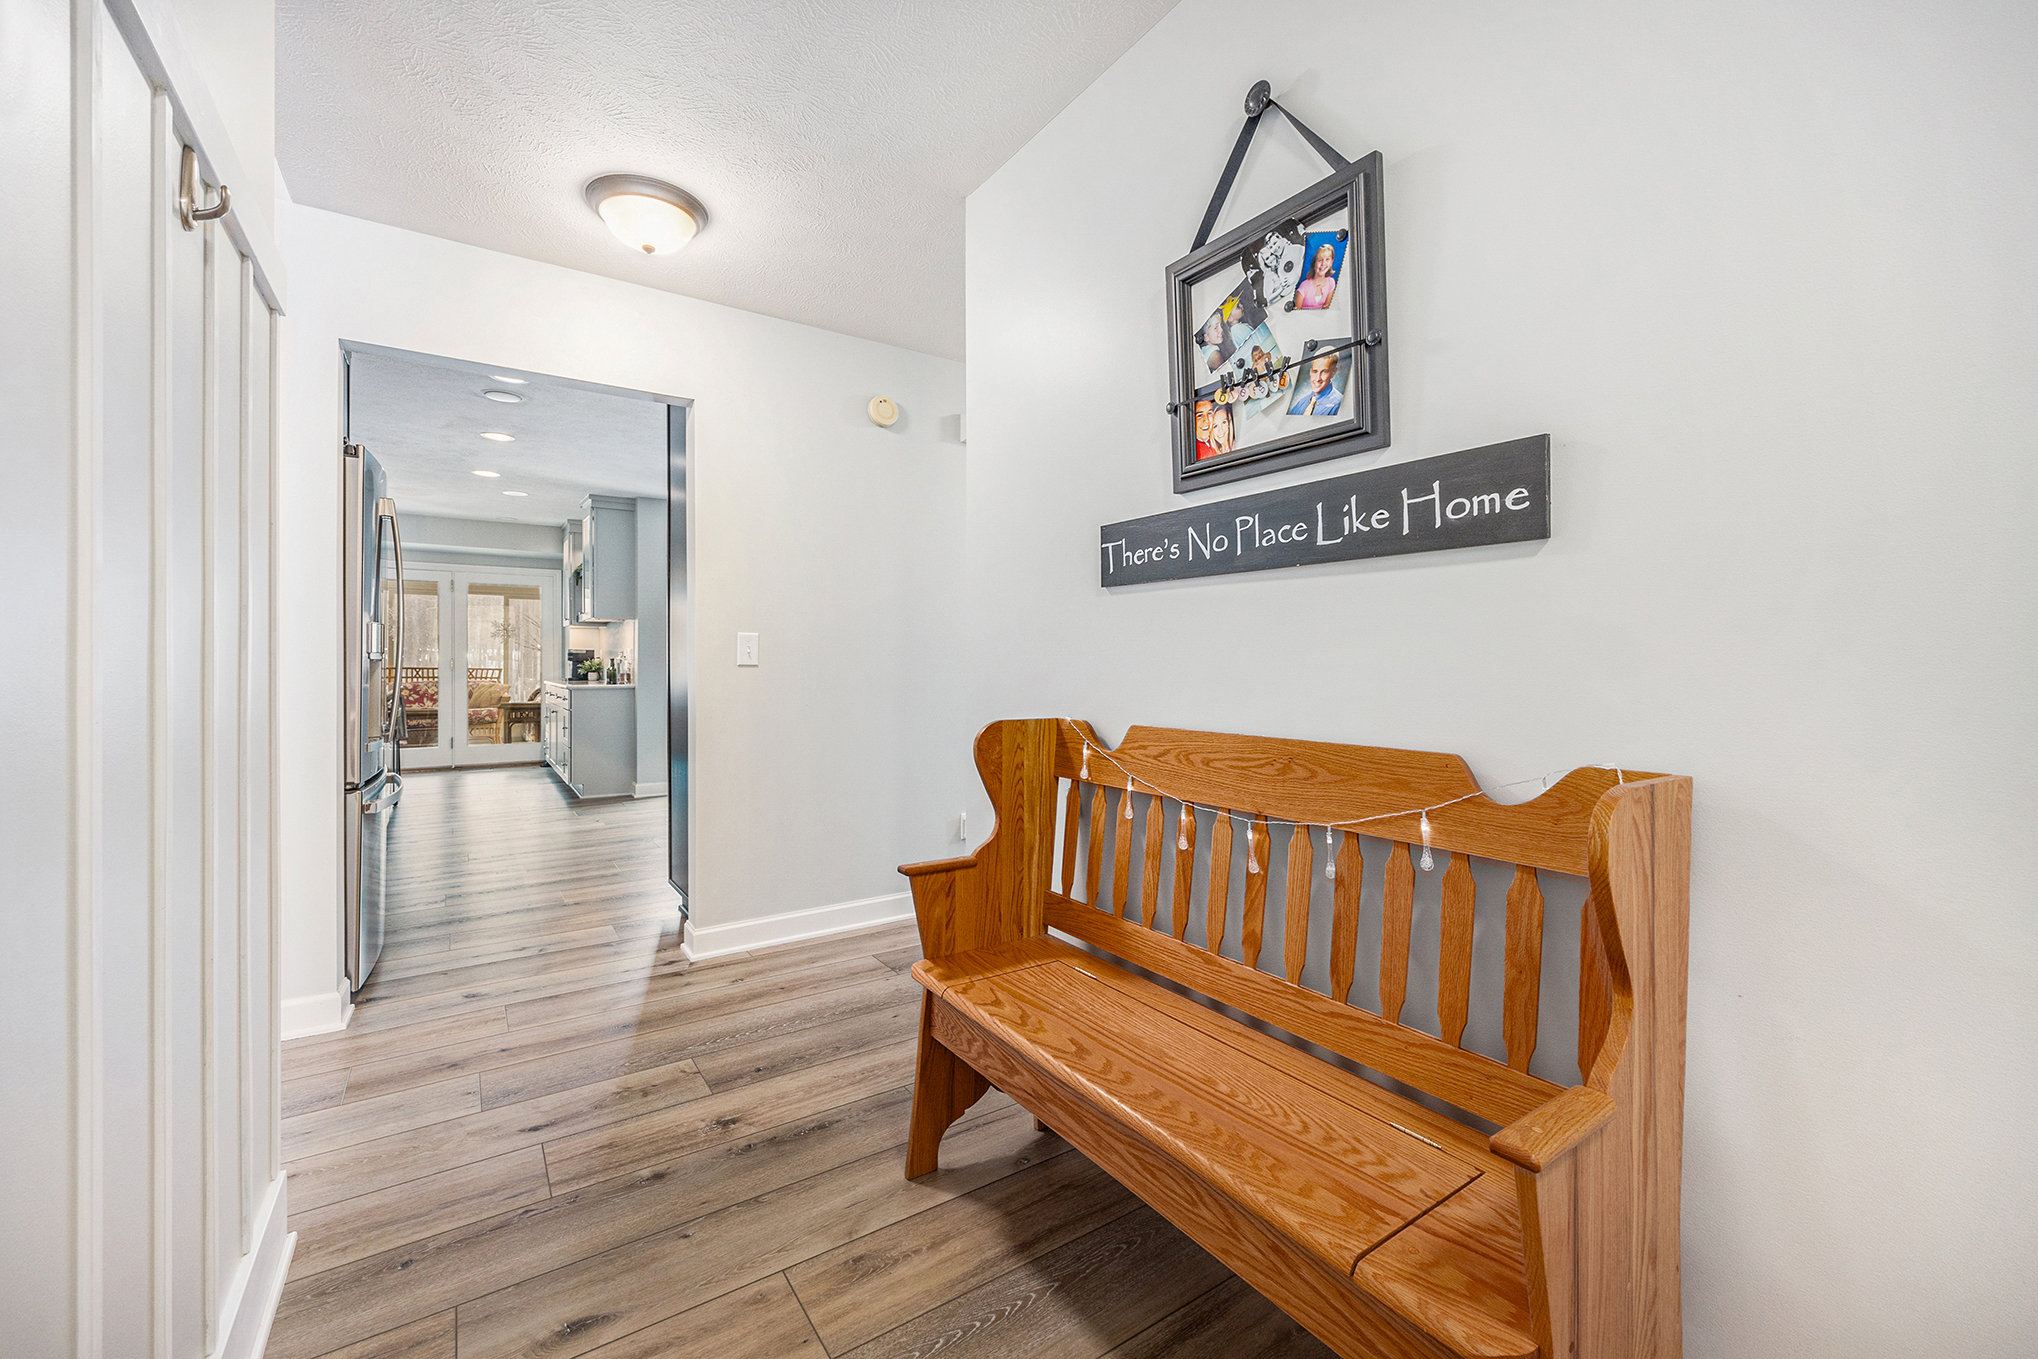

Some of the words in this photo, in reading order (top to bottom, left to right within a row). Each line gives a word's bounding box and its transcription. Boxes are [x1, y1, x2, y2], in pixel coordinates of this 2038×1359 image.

[1101, 537, 1180, 575] There's
[1187, 522, 1229, 562] No
[1235, 514, 1309, 557] Place
[1316, 494, 1391, 546] Like
[1401, 479, 1531, 536] Home
